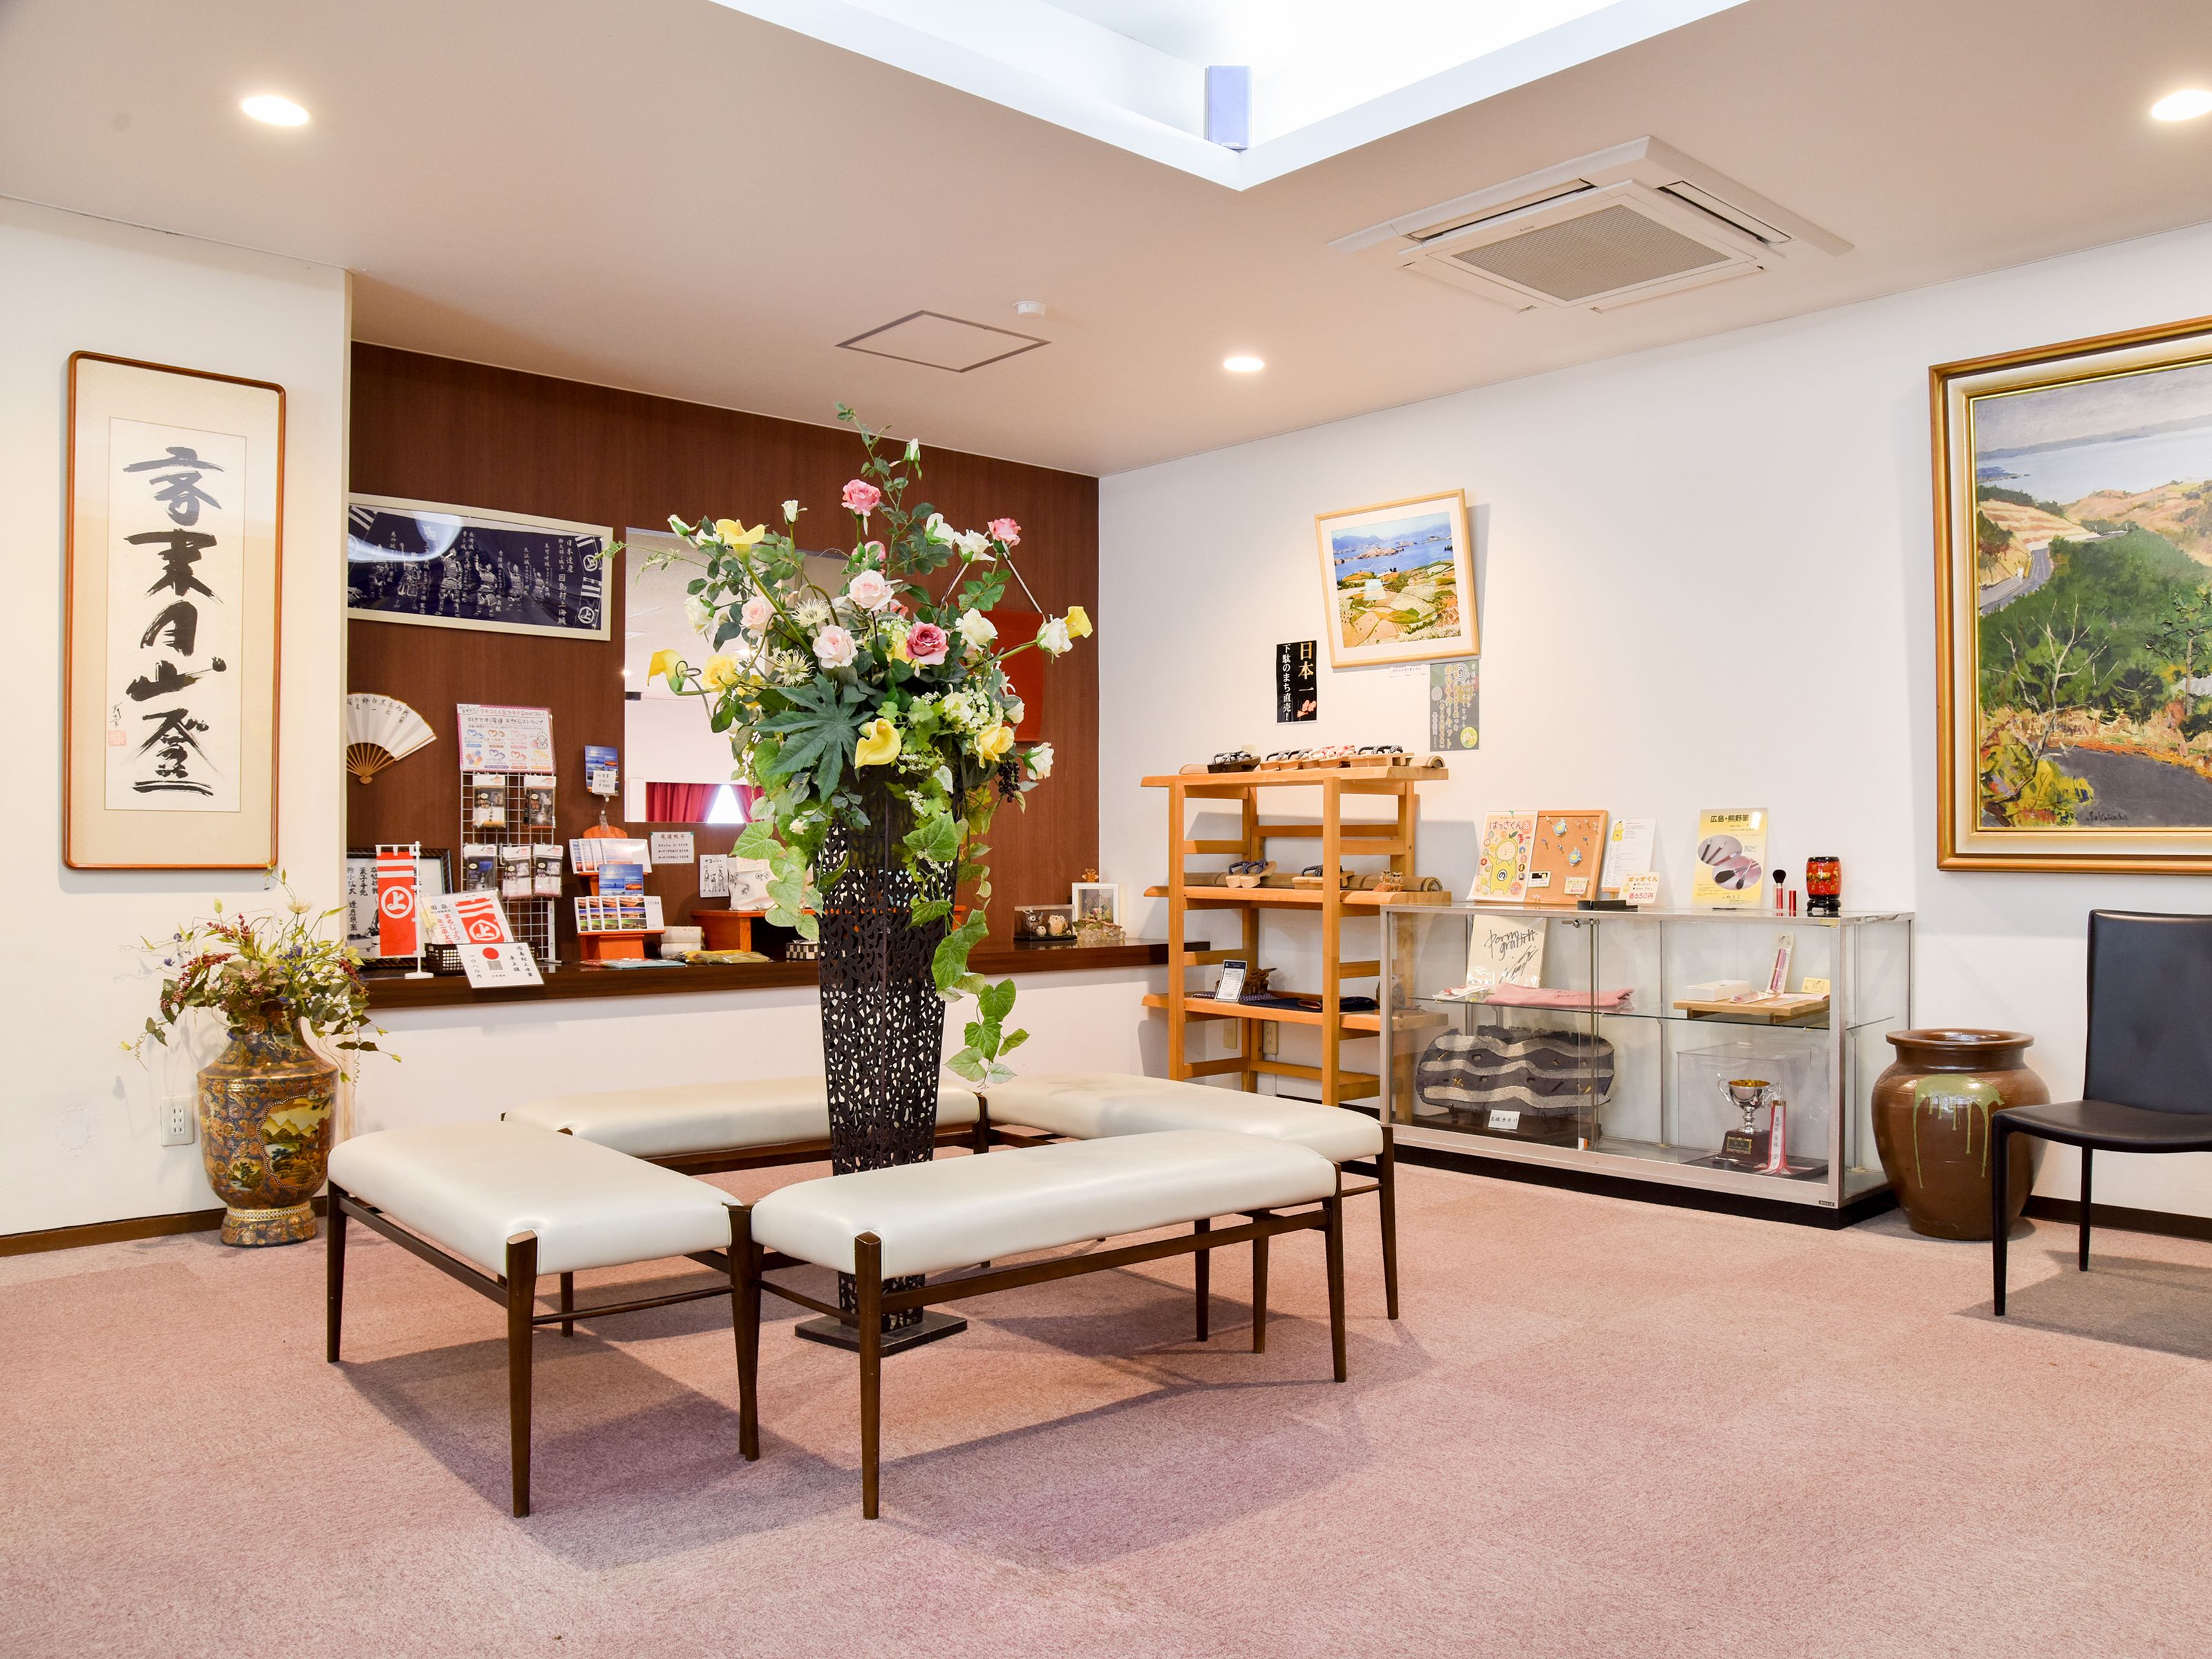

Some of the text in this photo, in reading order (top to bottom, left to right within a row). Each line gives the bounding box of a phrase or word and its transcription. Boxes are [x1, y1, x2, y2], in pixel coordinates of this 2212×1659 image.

[1282, 644, 1291, 721] 下駄のまち直売！
[1299, 642, 1314, 691] 日本一
[1490, 820, 1523, 830] はっさくん
